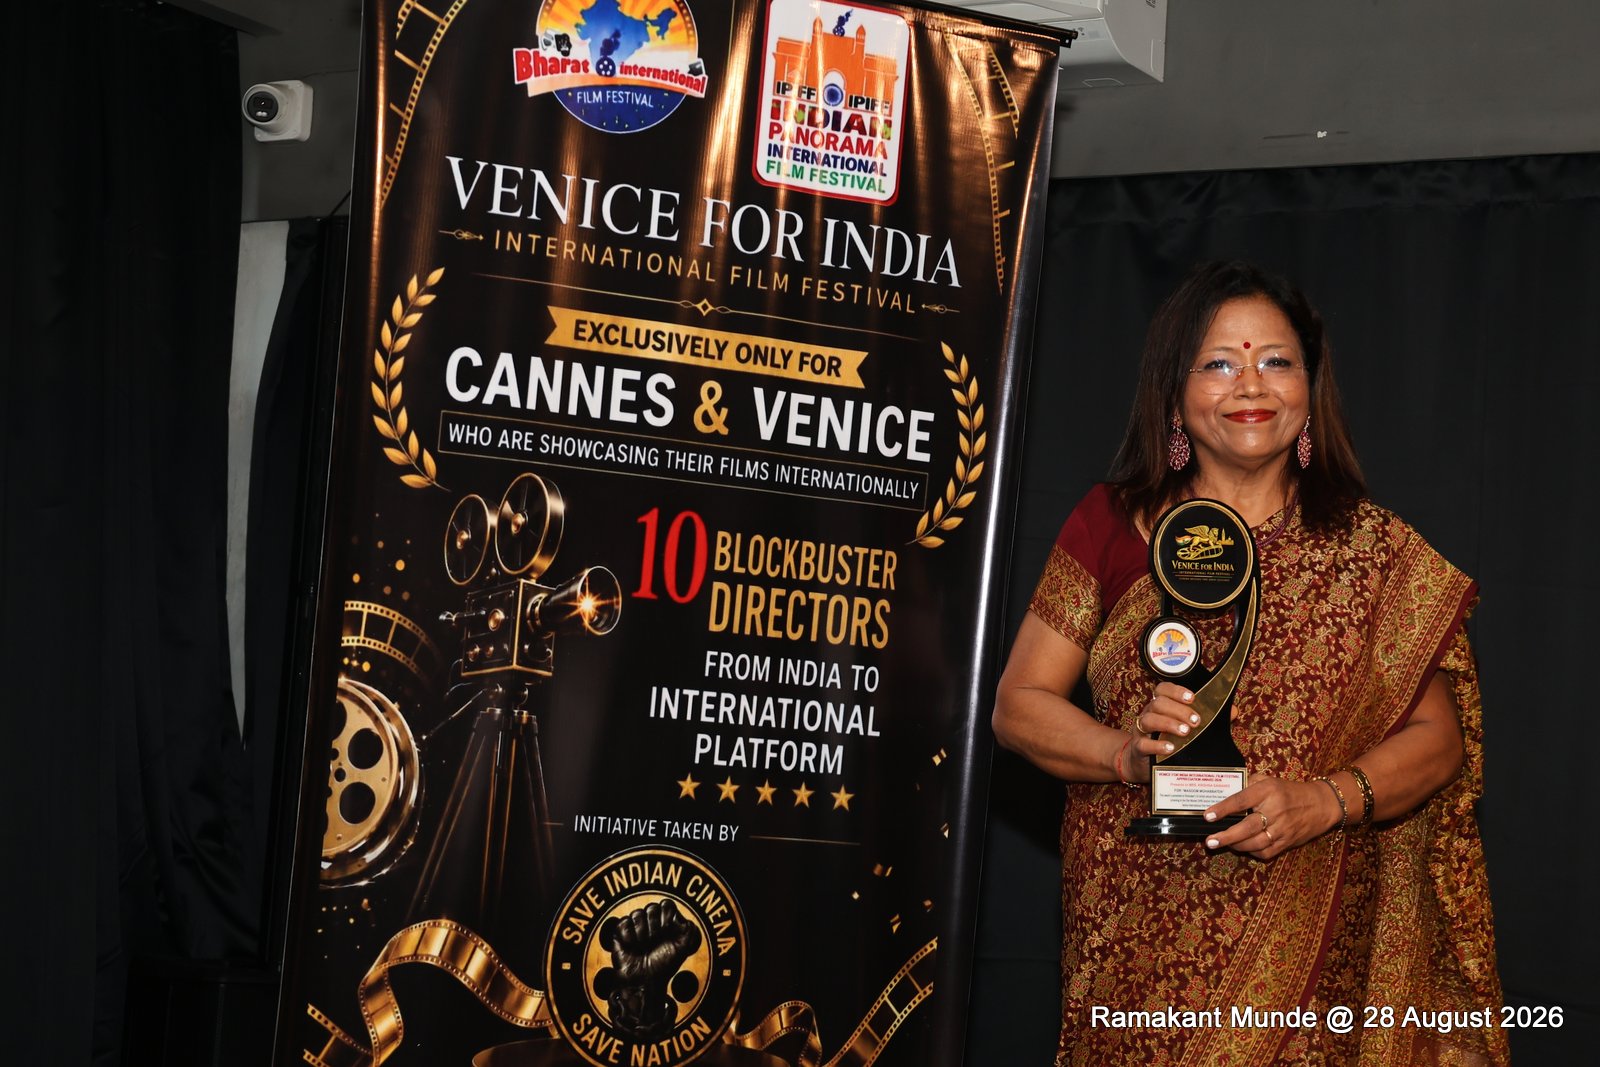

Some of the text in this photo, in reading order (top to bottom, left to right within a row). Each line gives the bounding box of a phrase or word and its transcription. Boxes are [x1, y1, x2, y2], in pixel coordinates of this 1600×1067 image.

[515, 50, 707, 94] Bharat international
[776, 81, 817, 100] IPFF
[576, 91, 654, 108] FILM FESTIVAL
[770, 98, 893, 141] INDIAN
[767, 143, 887, 177] INTERNATIONAL
[768, 121, 888, 160] PANORAMA
[809, 168, 886, 194] FESTIVAL
[445, 155, 962, 288] VENICE FOR INDIA
[494, 229, 916, 315] INTERNATIONAL FILM FESTIVAL
[573, 319, 842, 379] EXCLUSIVELY ONLY FOR
[445, 346, 936, 463] CANNES & VENICE
[448, 422, 919, 500] WHO ARE SHOWCASING THEIR FILMS INTERNATIONALLY
[631, 507, 709, 604] 10
[713, 530, 898, 591] BLOCKBUSTER
[1171, 559, 1200, 570] VENICE
[1213, 561, 1235, 572] INDIA
[708, 581, 891, 649] DIRECTORS
[704, 650, 880, 693] FROM INDIA TO
[649, 686, 881, 737] INTERNATIONAL
[694, 733, 844, 775] PLATFORM
[574, 814, 740, 842] INITIATIVE TAKEN BY
[562, 887, 606, 945] SAVE
[604, 861, 683, 897] INDIAN
[572, 1013, 712, 1067] SAVE NATION
